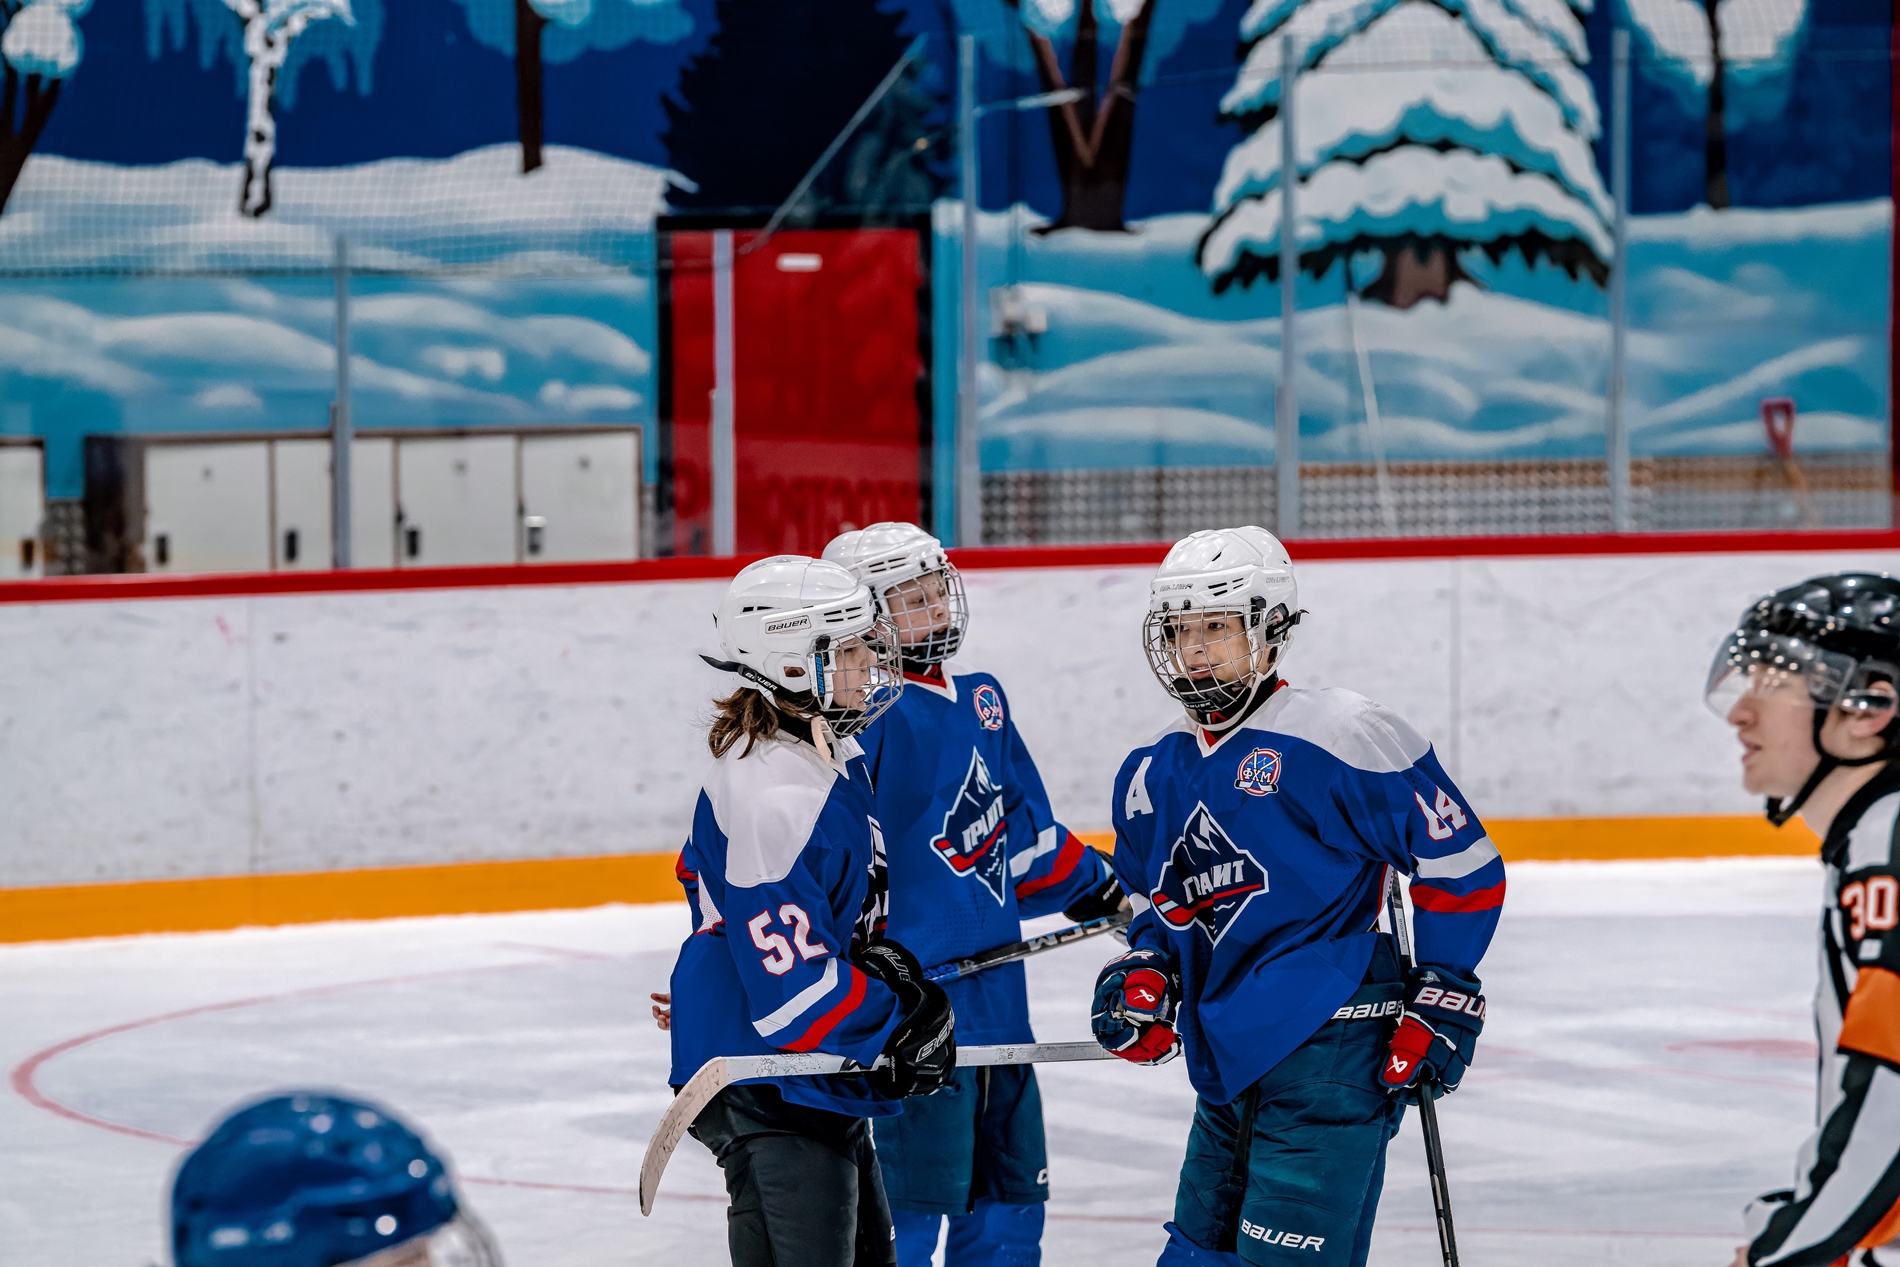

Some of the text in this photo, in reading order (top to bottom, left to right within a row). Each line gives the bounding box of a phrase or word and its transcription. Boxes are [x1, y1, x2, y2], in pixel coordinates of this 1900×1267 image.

[767, 618, 808, 632] BAUER
[815, 656, 825, 694] BAUER
[1125, 756, 1154, 820] A
[1243, 767, 1272, 783] ФХМ
[1840, 875, 1899, 941] 30
[747, 902, 830, 976] 52
[1241, 1218, 1325, 1252] BAUER
